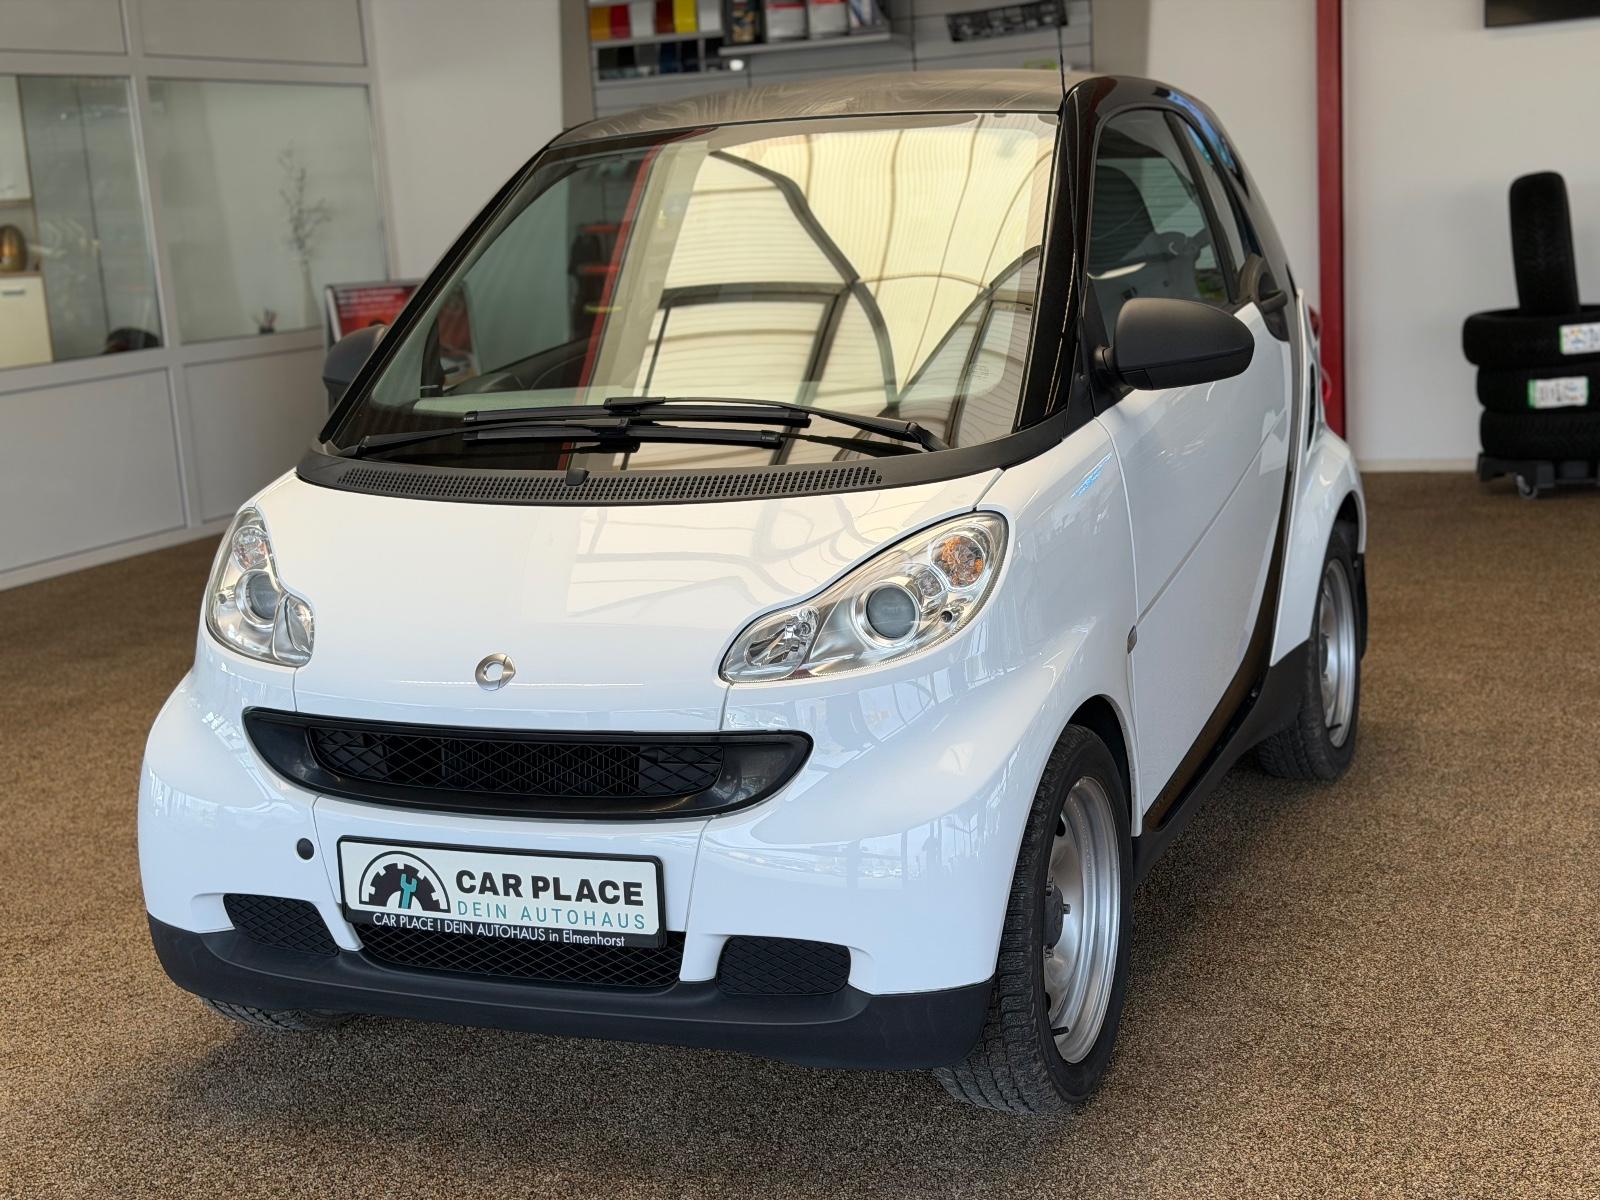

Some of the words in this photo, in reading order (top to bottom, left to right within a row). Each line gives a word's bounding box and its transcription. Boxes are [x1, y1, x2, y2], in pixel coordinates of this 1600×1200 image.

[456, 869, 523, 898] CAR
[531, 875, 644, 907] PLACE
[372, 912, 397, 927] CAR
[400, 915, 434, 931] PLACE
[444, 920, 473, 935] DEIN
[476, 923, 546, 941] AUTOHAUS
[549, 929, 559, 942] in
[563, 930, 625, 947] Elmenhorst
[457, 900, 507, 919] DEIN
[520, 905, 645, 930] AUTOHAUS
